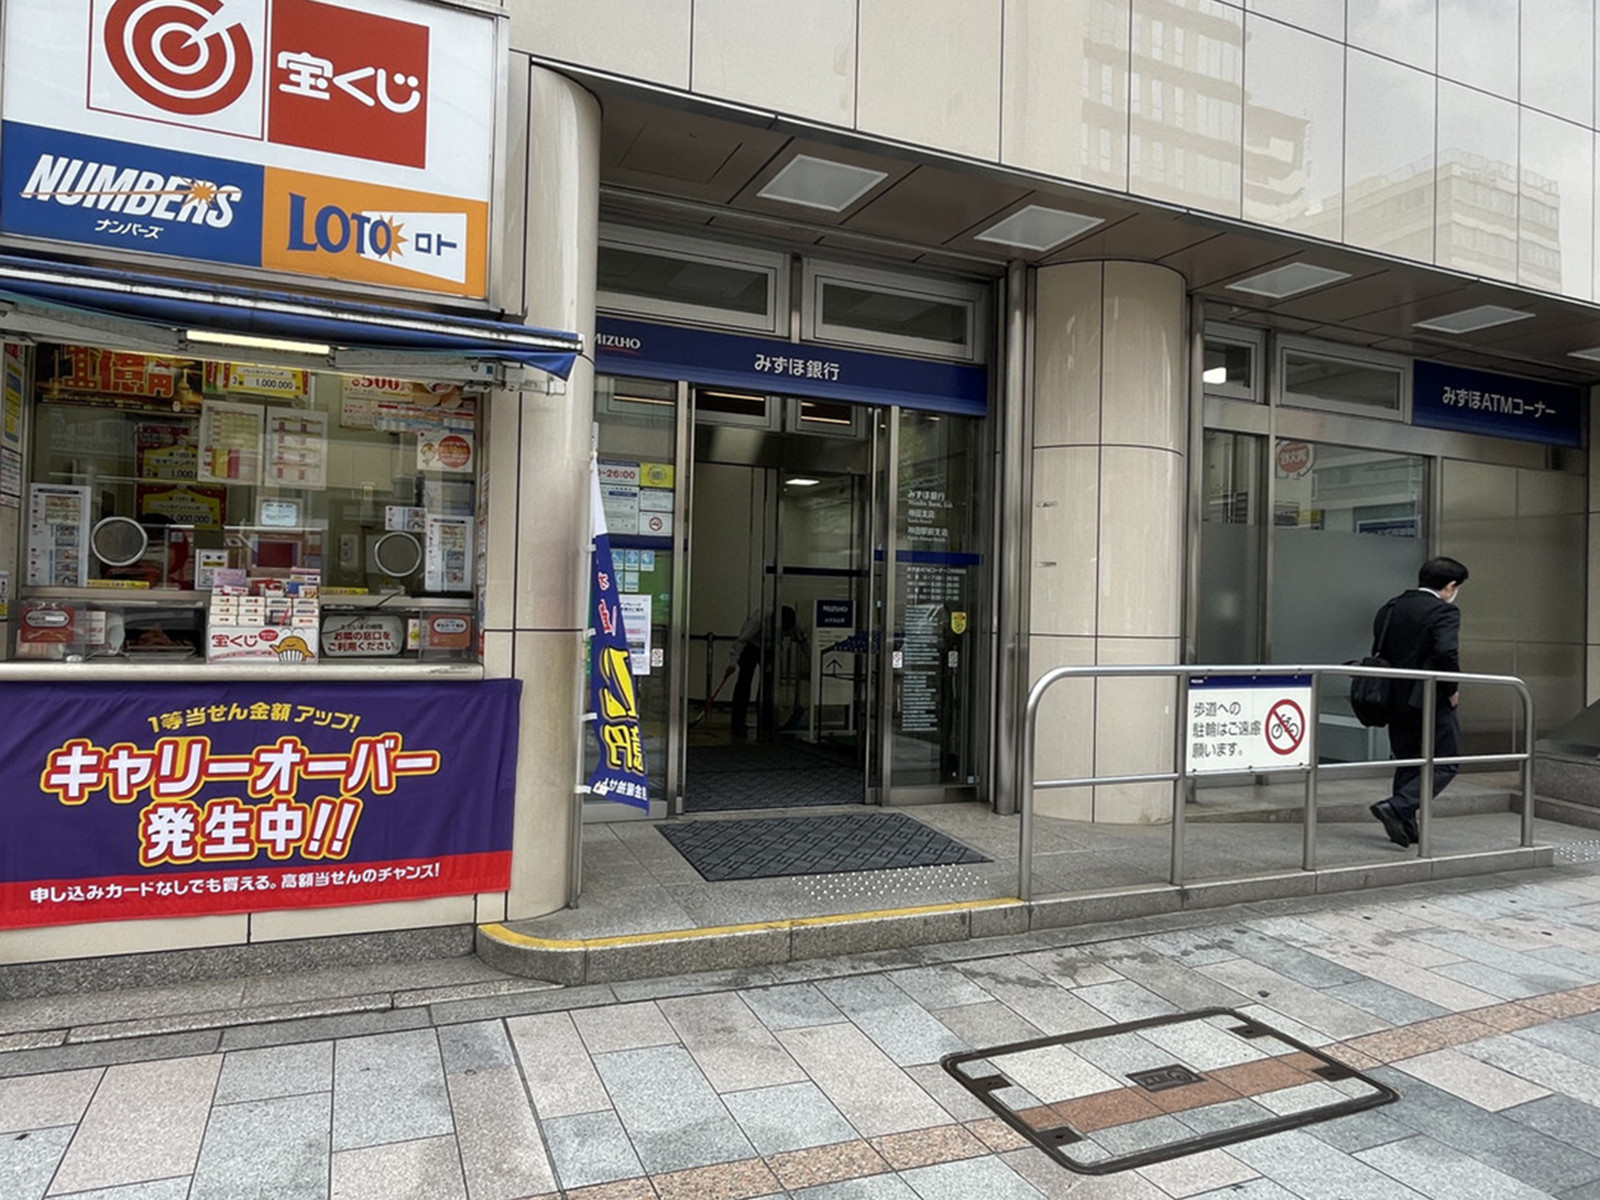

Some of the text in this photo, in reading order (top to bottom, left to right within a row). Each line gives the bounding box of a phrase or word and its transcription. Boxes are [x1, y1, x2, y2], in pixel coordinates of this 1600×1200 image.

[277, 51, 421, 114] 宝くじ
[21, 154, 243, 229] NUMBERS
[95, 218, 164, 240] ナンバーズ
[286, 193, 392, 256] LOTO
[415, 232, 457, 256] ロト
[754, 354, 840, 381] みずほ銀行
[1442, 386, 1556, 418] みずほATMコーナー
[212, 634, 248, 648] 宝くじ
[1193, 702, 1241, 718] 歩道への
[1193, 720, 1261, 738] 駐輪はご遠慮
[1192, 743, 1243, 758] 願います。
[40, 730, 441, 805] キャリーオーバー
[137, 797, 363, 866] 発生中!!
